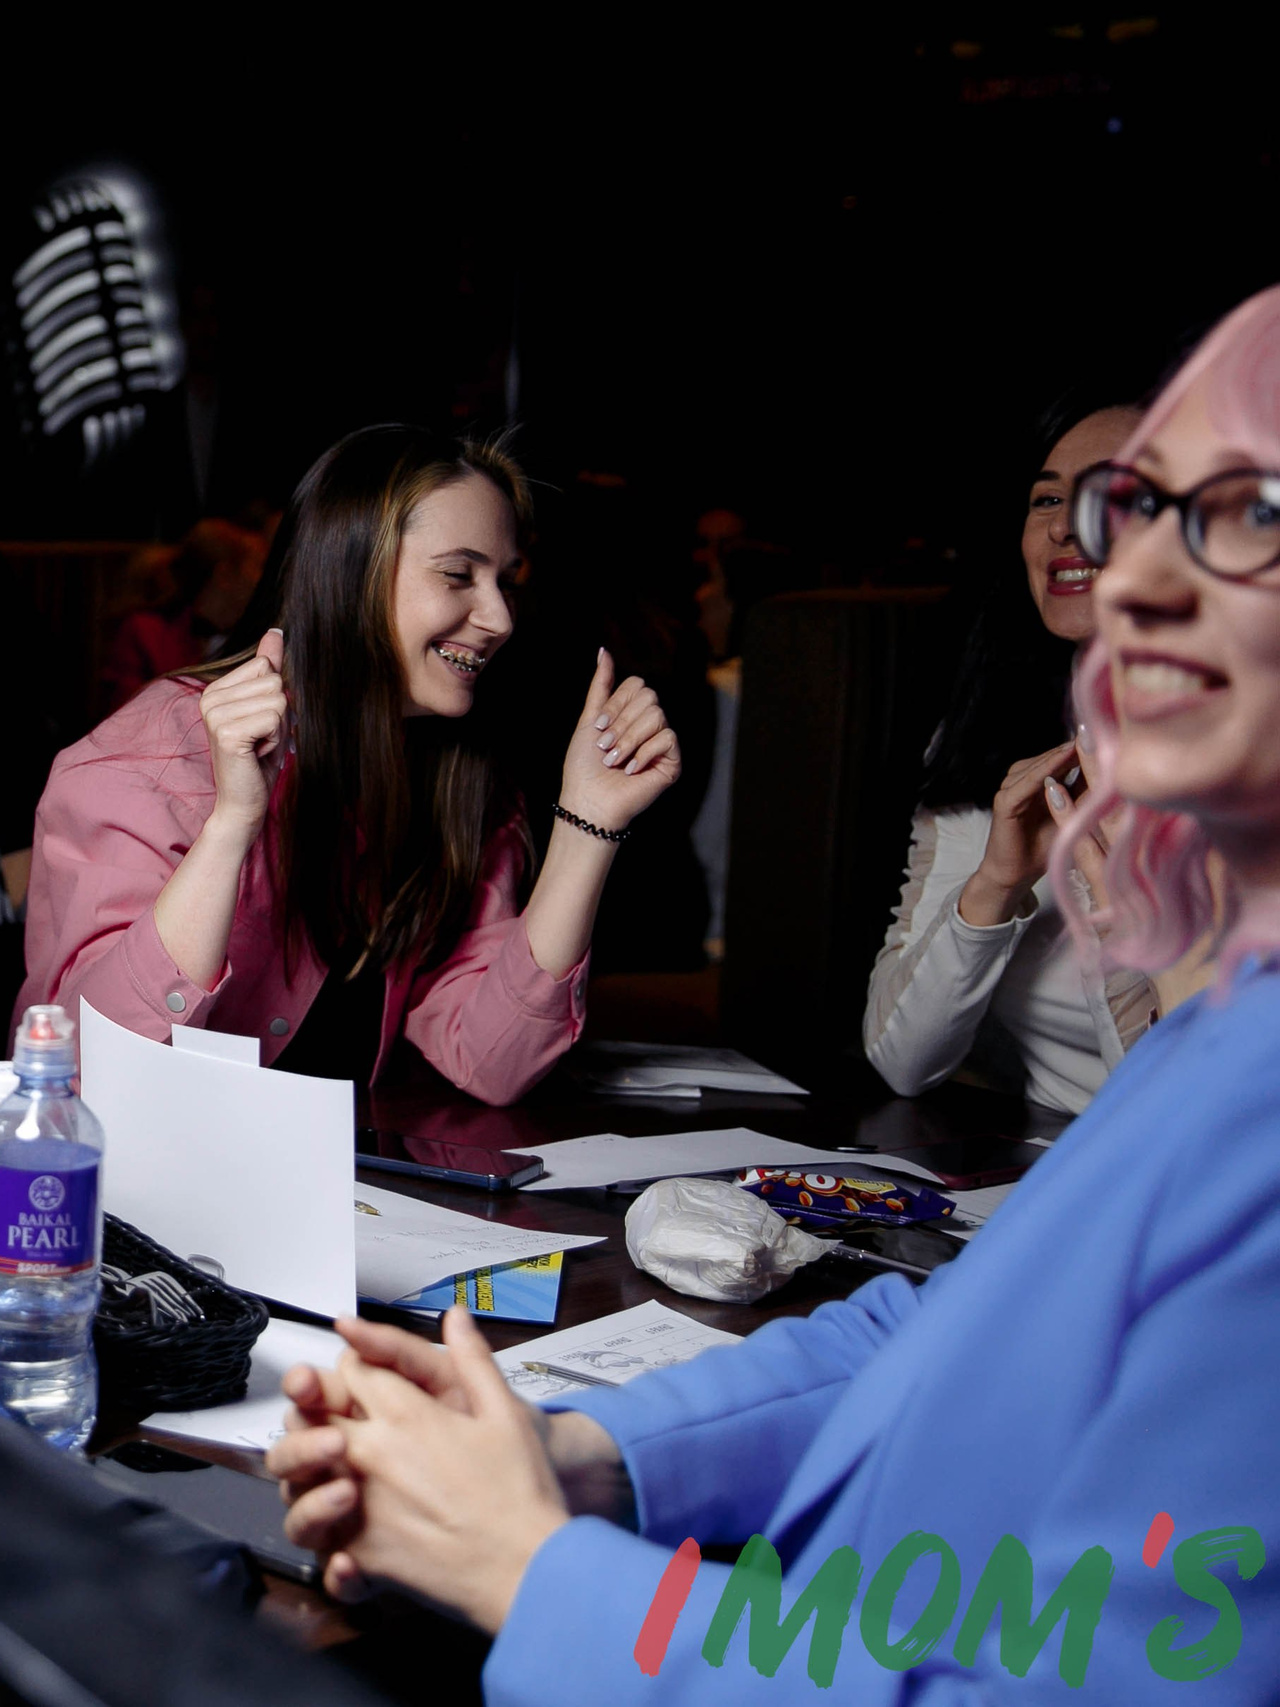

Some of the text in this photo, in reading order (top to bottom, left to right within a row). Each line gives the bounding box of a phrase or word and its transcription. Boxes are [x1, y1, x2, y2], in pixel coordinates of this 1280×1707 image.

[18, 1212, 71, 1226] BAIKAL
[7, 1225, 80, 1248] PEARL
[16, 1262, 57, 1273] SPORT
